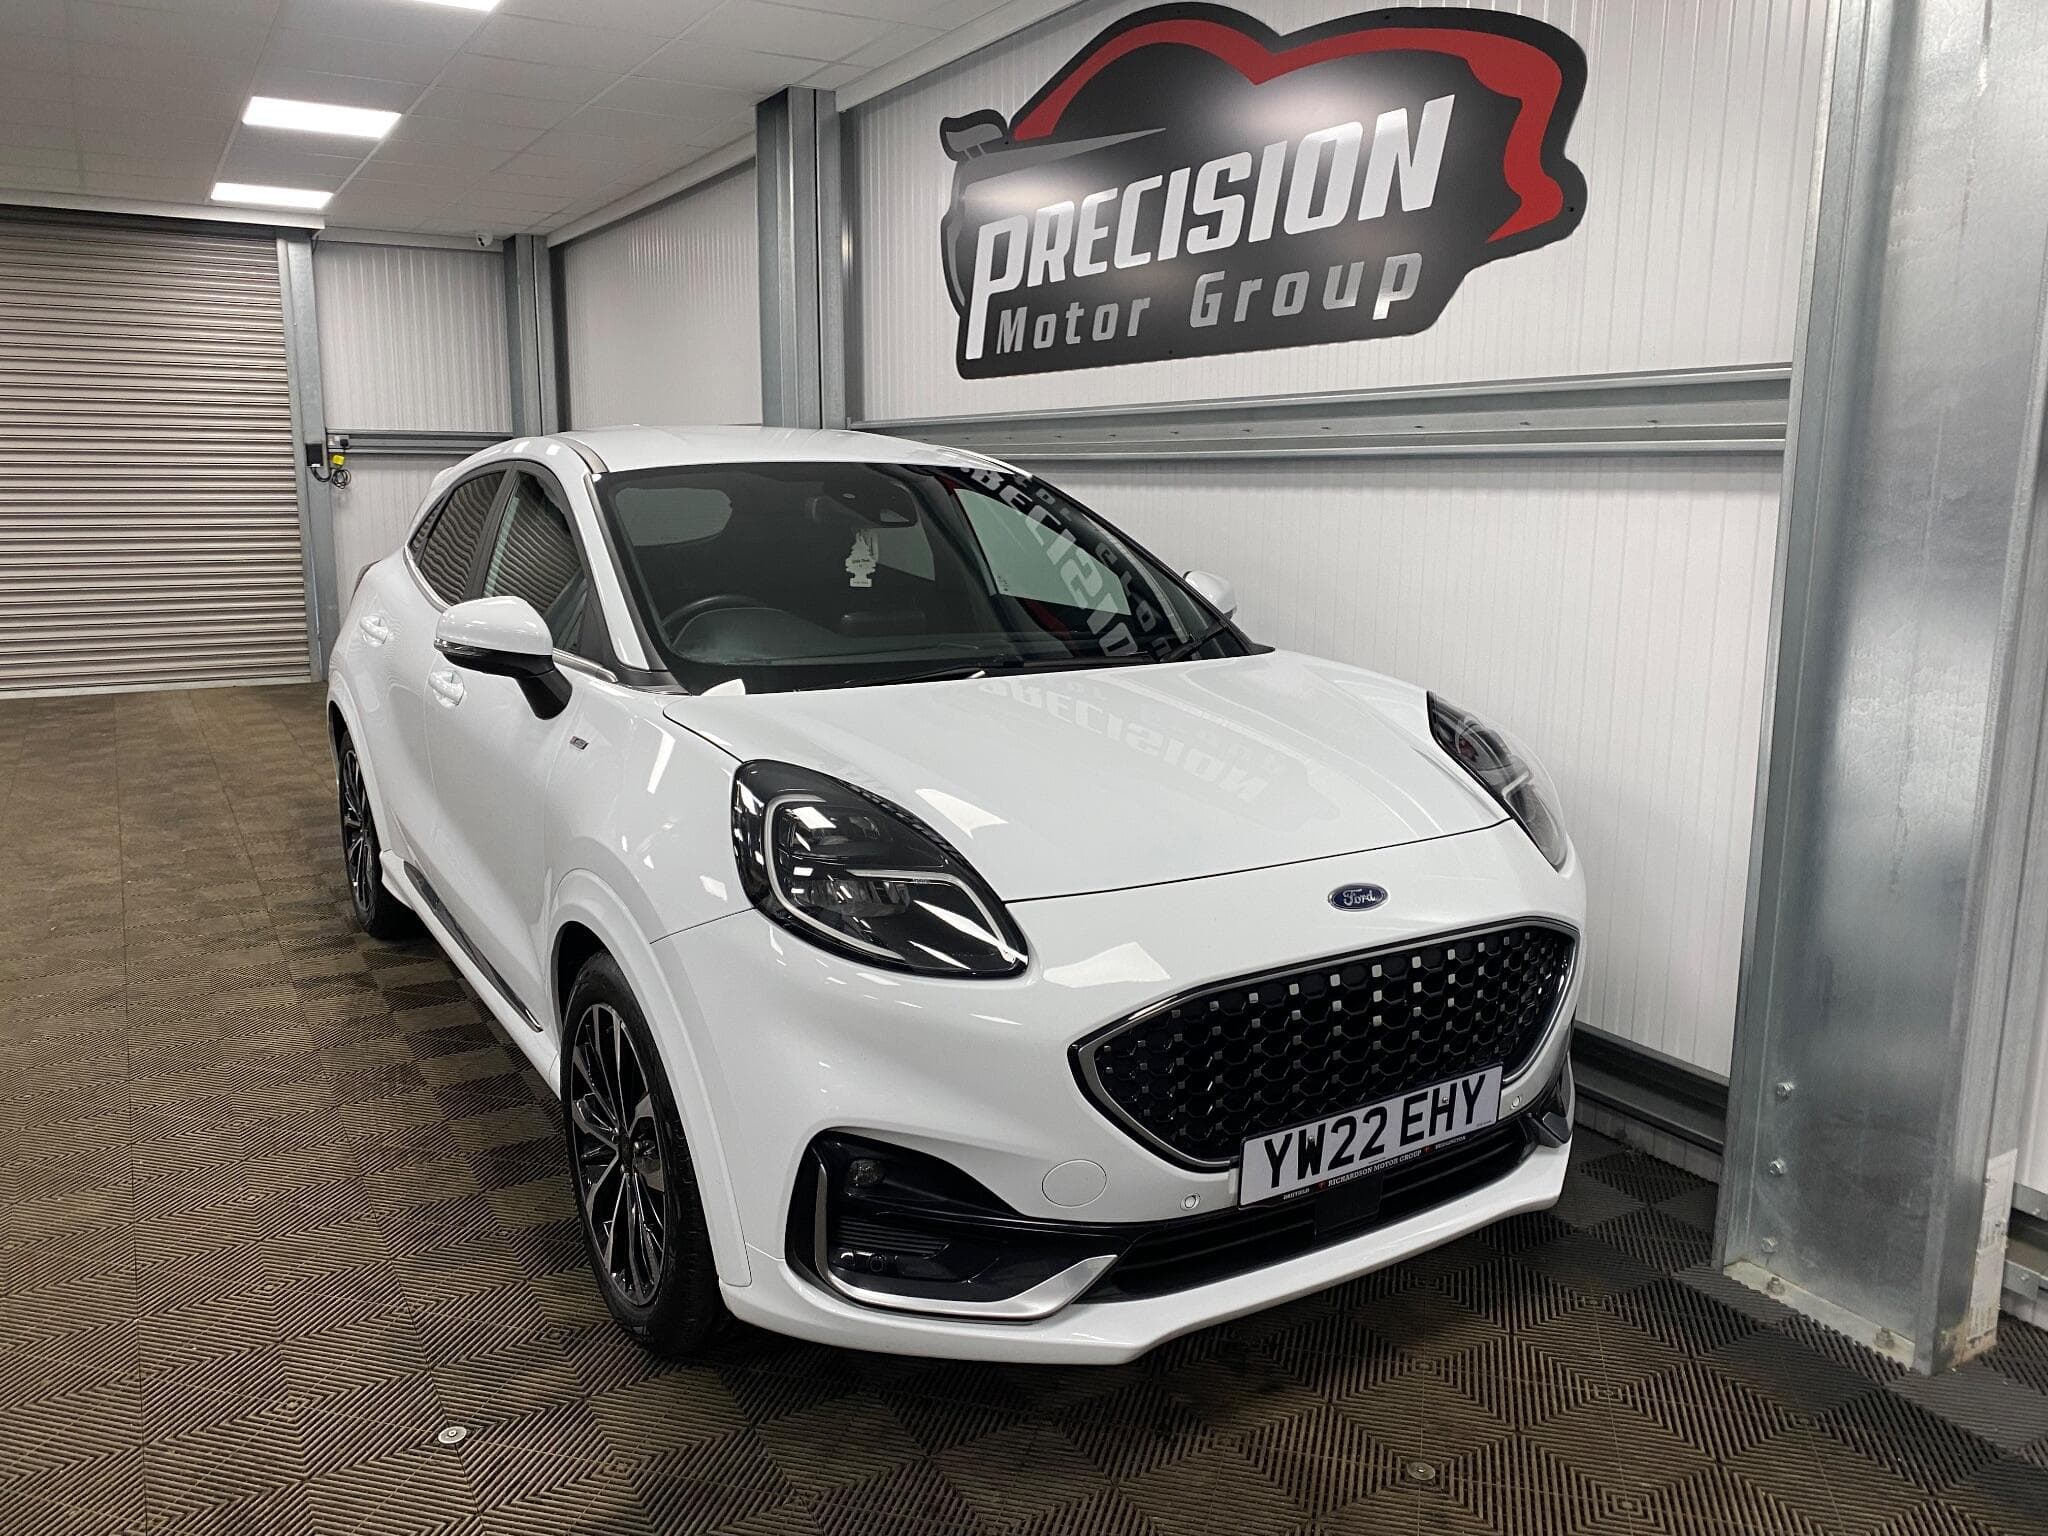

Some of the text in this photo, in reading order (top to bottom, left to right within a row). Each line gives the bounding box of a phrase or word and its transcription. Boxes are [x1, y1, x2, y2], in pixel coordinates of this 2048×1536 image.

[965, 93, 1455, 360] PRECISION
[996, 252, 1422, 354] Motor Group
[1342, 888, 1376, 906] Ford
[1263, 1074, 1486, 1189] YW22 EHY
[1327, 1166, 1373, 1187] RICHARDSON
[1373, 1157, 1399, 1172] MOTOR
[1399, 1149, 1422, 1163] GROUP
